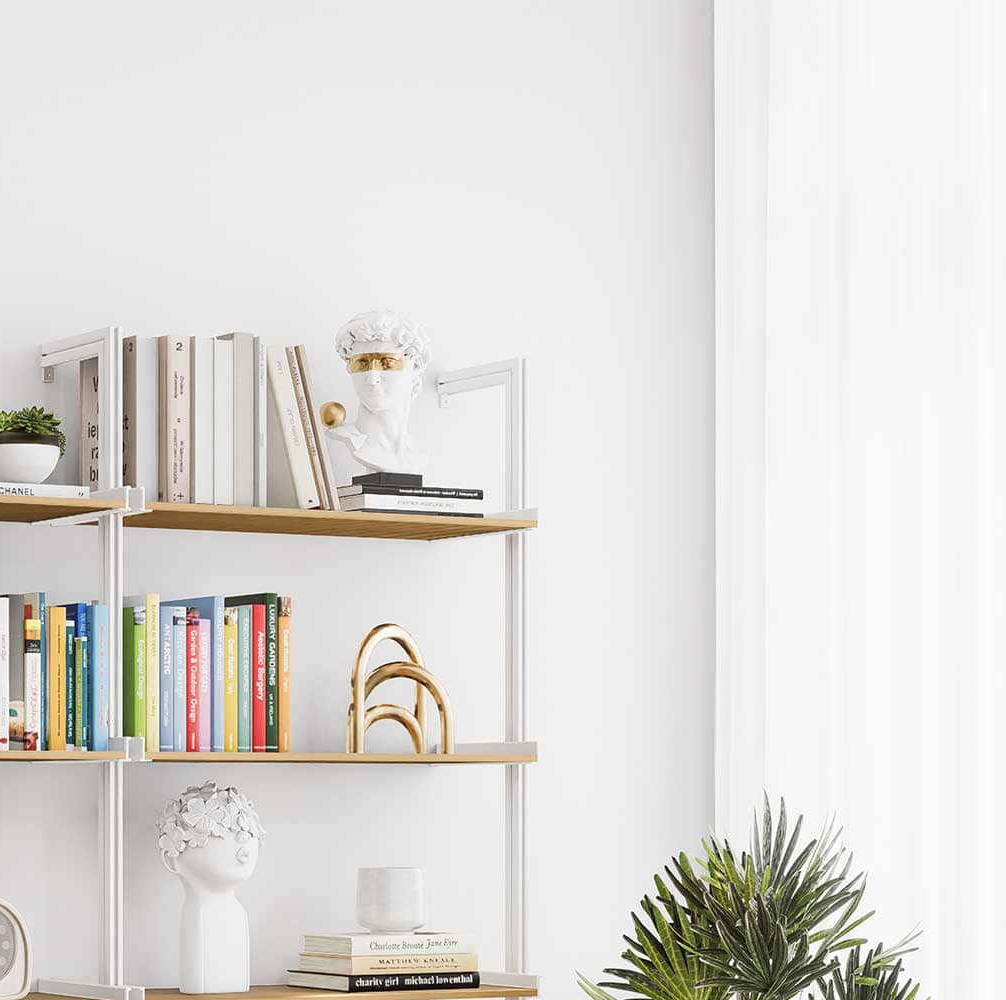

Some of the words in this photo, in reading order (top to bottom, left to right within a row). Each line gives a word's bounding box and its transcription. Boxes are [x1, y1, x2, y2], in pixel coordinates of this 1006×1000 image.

[176, 342, 183, 351] 2
[256, 668, 264, 701] Surgery
[369, 941, 401, 951] Charlotte
[355, 978, 383, 988] charity
[384, 976, 399, 988] girl
[404, 975, 434, 986] michael
[435, 974, 474, 985] lowenthal
